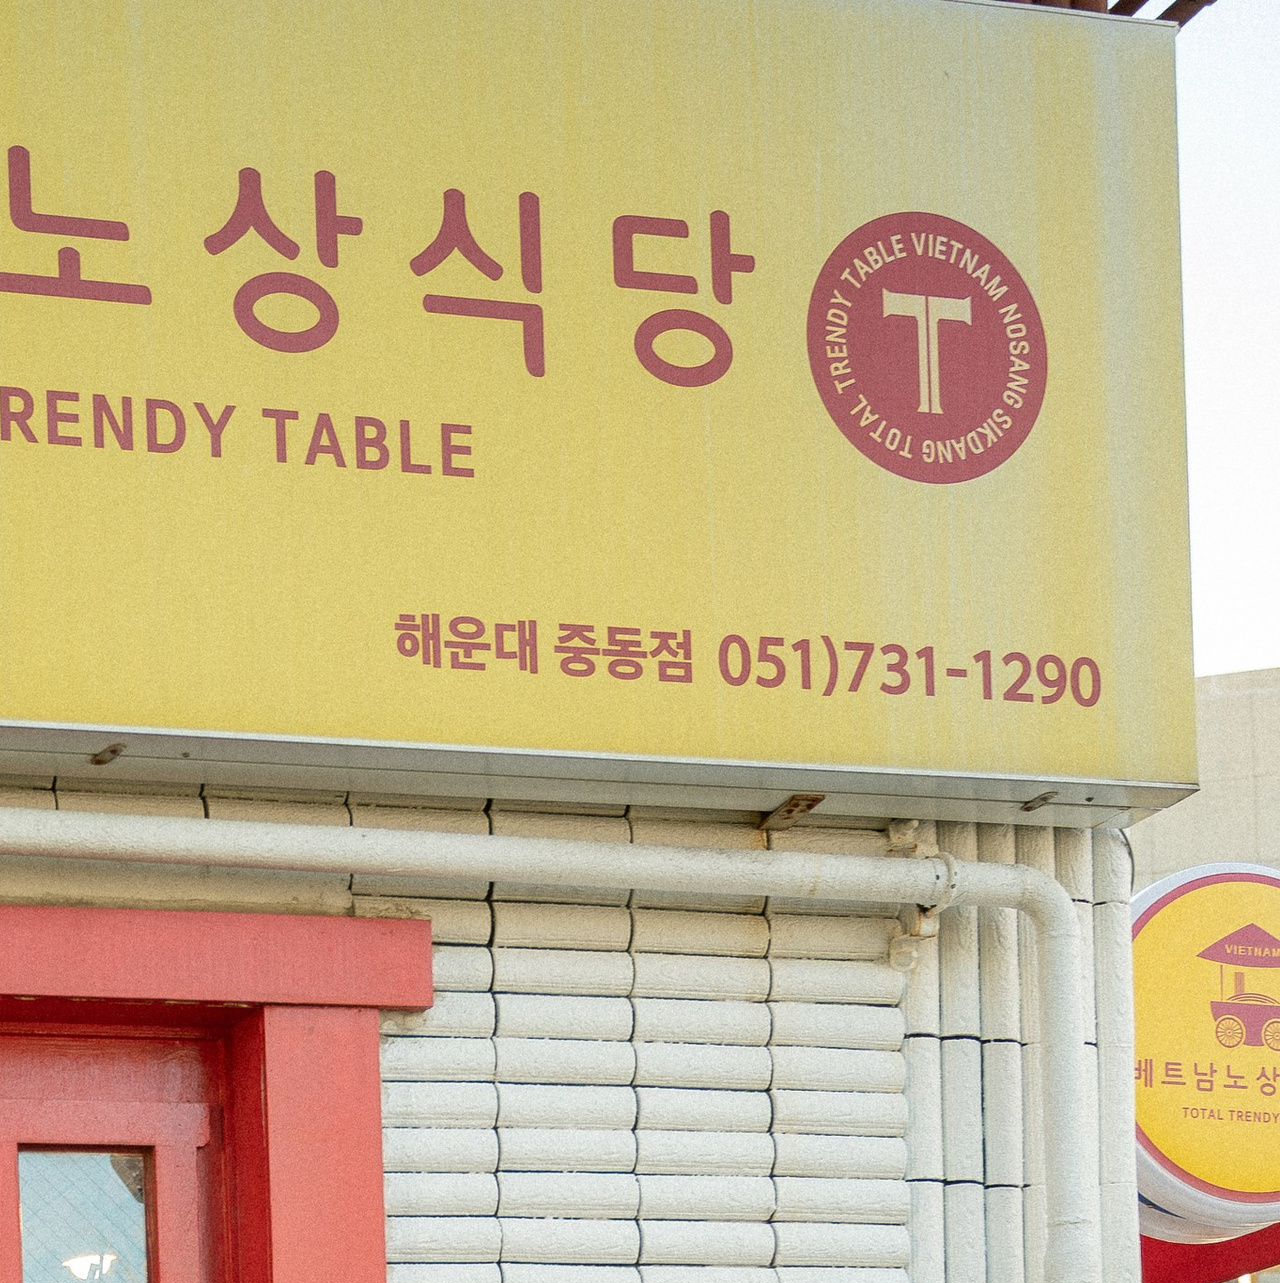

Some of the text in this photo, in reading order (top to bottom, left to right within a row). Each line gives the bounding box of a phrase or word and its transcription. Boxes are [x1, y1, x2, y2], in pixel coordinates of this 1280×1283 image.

[825, 233, 1030, 463] TOTAL TRENDY TABLE VIETNAM NOSANG SIKDANG
[882, 288, 972, 414] T
[261, 408, 475, 478] TABLE
[395, 613, 1101, 707] 해운대 중동점 051)731-1290
[1225, 944, 1280, 958] VIETNAM
[1182, 1107, 1280, 1124] TOTAL TRENDY
